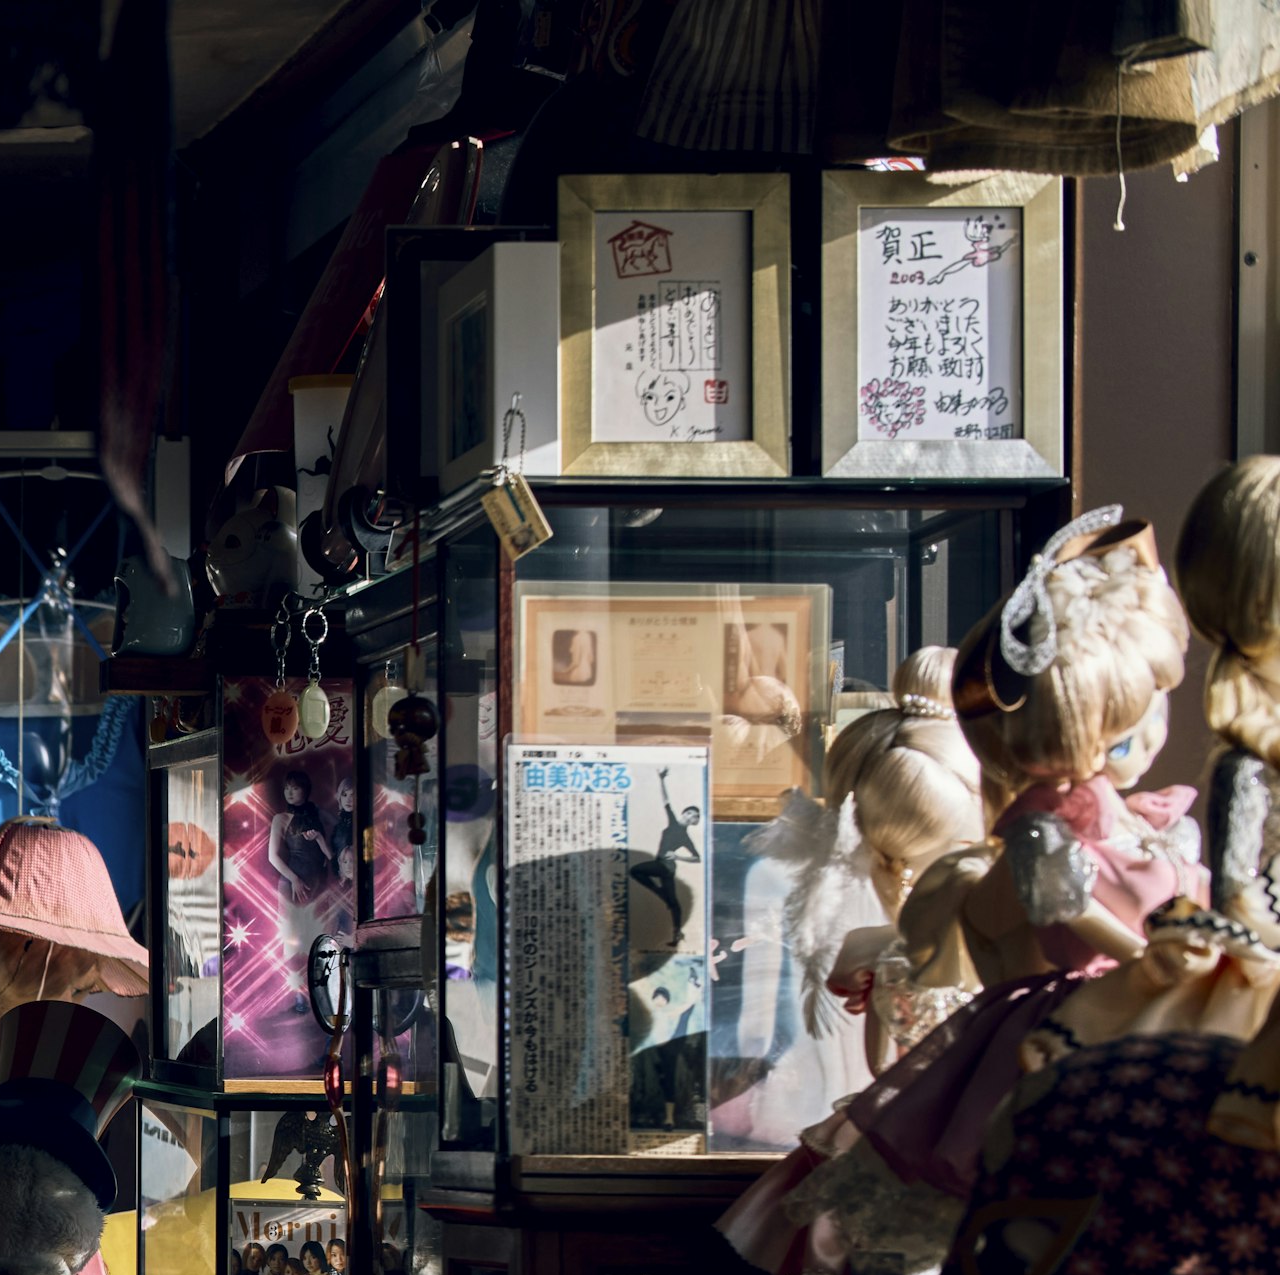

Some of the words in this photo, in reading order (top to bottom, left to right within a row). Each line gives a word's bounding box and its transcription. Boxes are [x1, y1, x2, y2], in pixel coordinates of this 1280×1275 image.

[876, 226, 942, 265] 賀正
[890, 271, 926, 285] 2003
[889, 296, 980, 315] ありがとう
[885, 315, 981, 335] ございました
[887, 333, 984, 357] 今年もよろしく
[265, 705, 293, 716] モーニング
[525, 765, 632, 791] 由美かおる
[523, 915, 538, 1093] 10代のジーンズが今もはける
